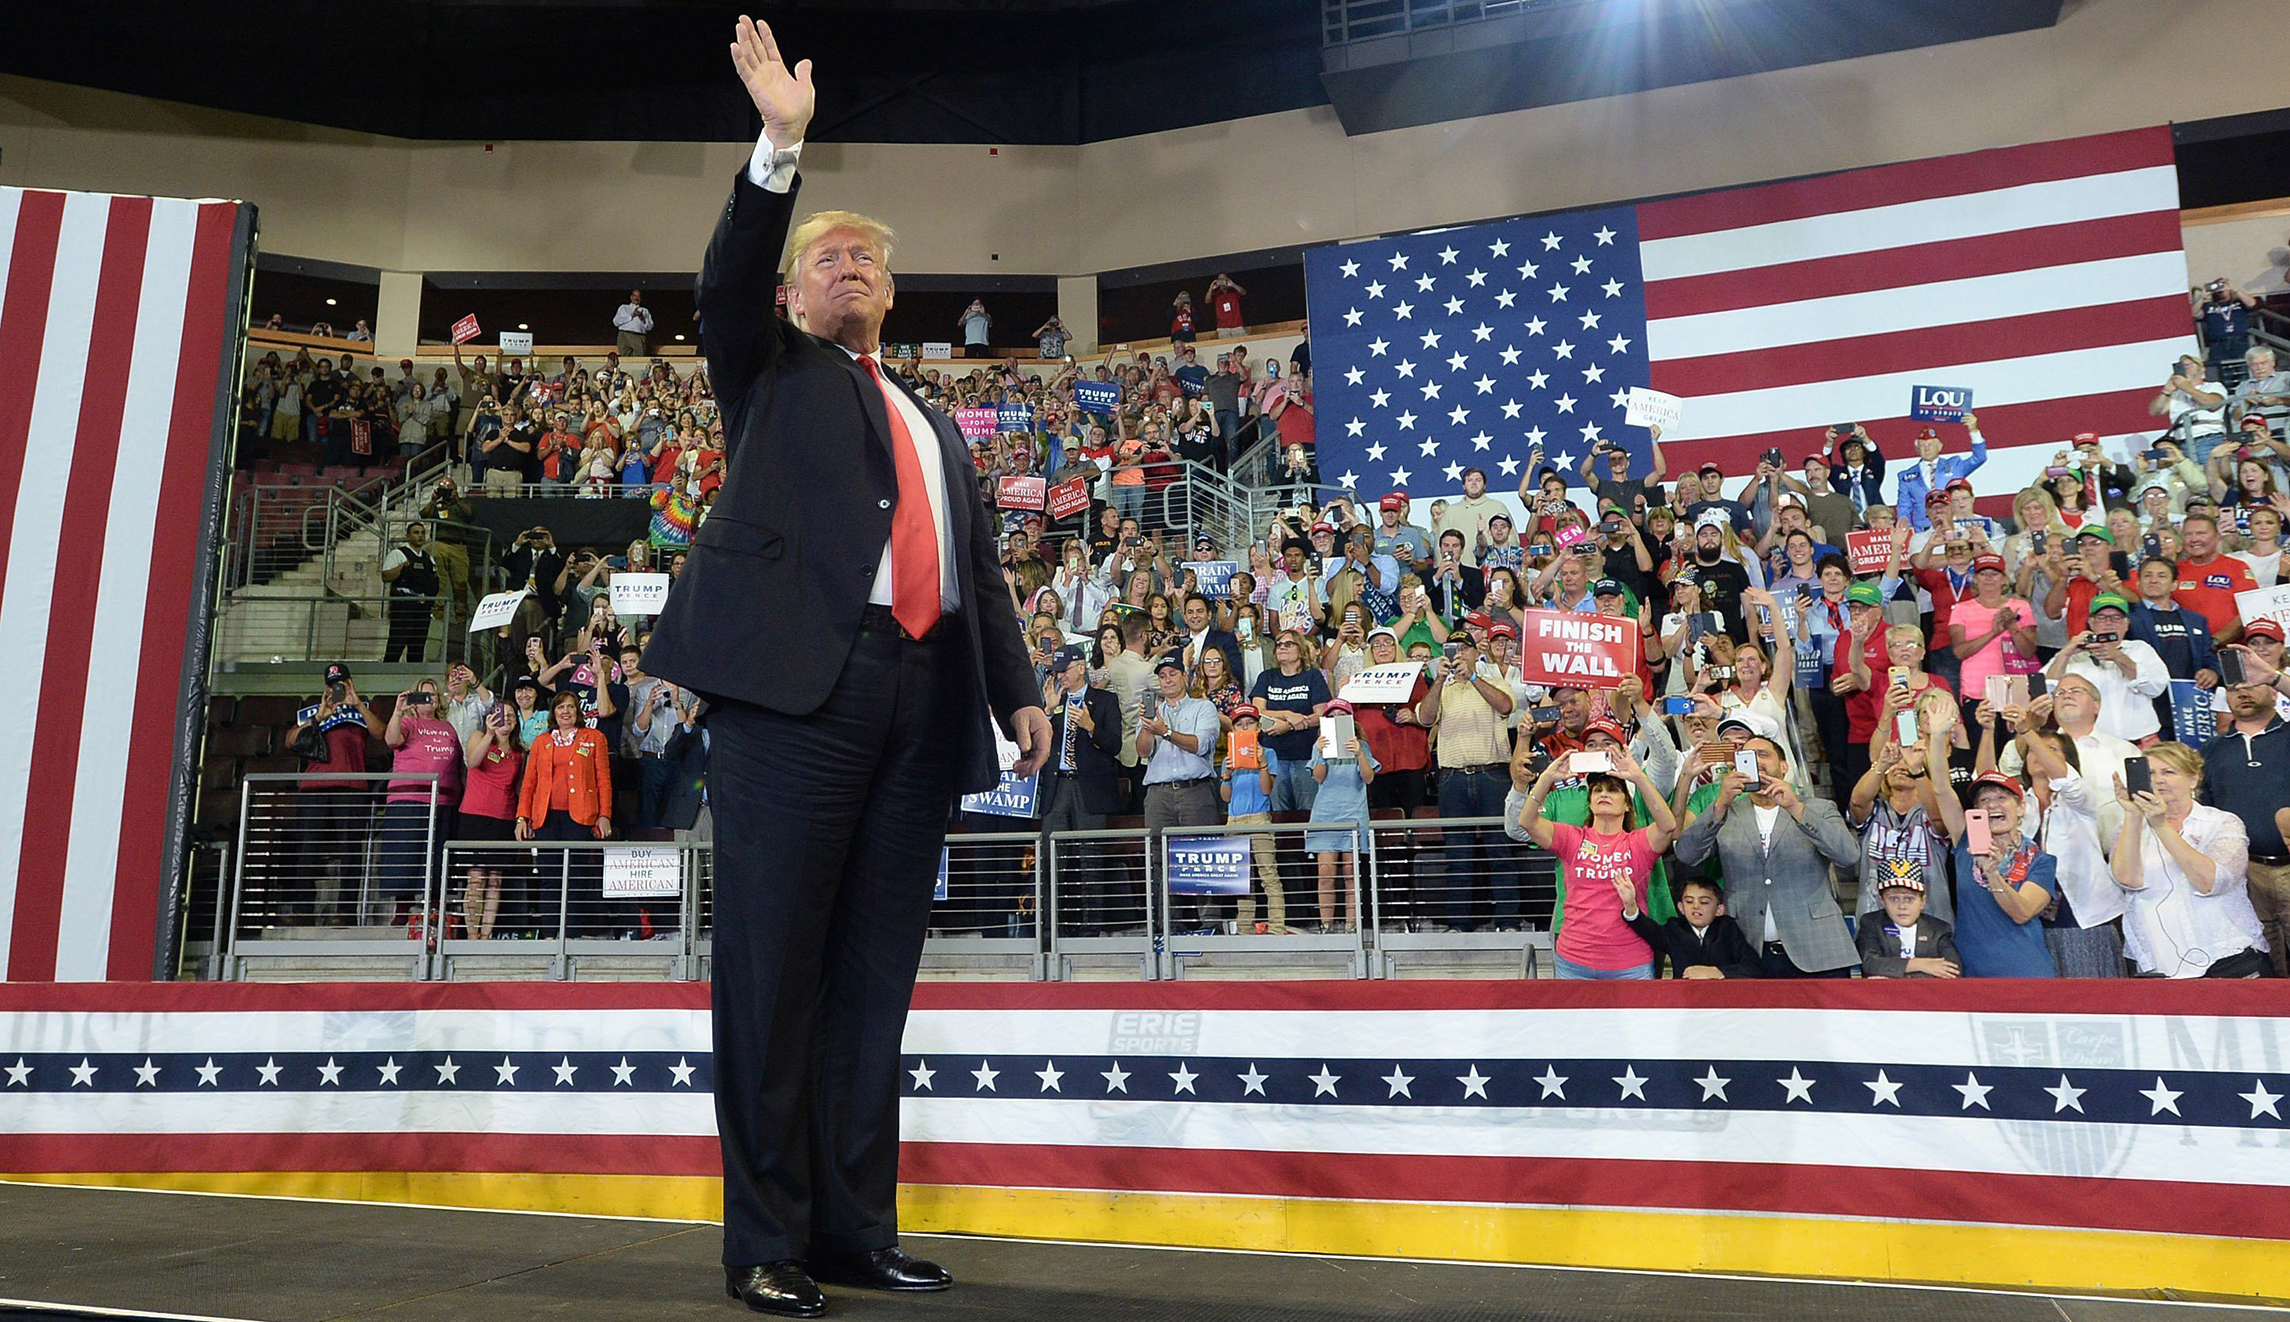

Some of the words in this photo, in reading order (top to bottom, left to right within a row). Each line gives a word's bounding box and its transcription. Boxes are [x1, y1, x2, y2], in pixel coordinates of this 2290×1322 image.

[1078, 389, 1116, 398] TRUMP
[1919, 388, 1965, 407] LOU
[957, 410, 997, 419] WOMEN
[999, 411, 1032, 420] TRUMP
[1631, 403, 1679, 420] AMERICA
[1001, 486, 1043, 498] AMERICA
[1052, 488, 1086, 506] AMERICA
[1556, 525, 1582, 544] EN
[1858, 555, 1885, 565] GREAT
[2206, 575, 2230, 584] LOU
[614, 585, 663, 593] TRUMP
[1197, 584, 1230, 594] WAM
[481, 598, 517, 609] TRUMP
[1539, 619, 1622, 643] FINISH
[1565, 642, 1592, 653] THE
[1541, 653, 1618, 677] WALL
[2182, 707, 2195, 736] MAKE
[425, 744, 454, 754] Trump
[997, 782, 1011, 792] HE
[968, 791, 1030, 809] SWAMP
[631, 850, 652, 858] BUY
[1175, 853, 1243, 864] TRUMP
[1576, 850, 1632, 864] WOMEN
[610, 858, 674, 869] AMERICAN
[1596, 862, 1613, 871] FOR
[630, 870, 653, 878] HIRE
[1575, 867, 1633, 879] TRUMP
[609, 879, 674, 890] AMERICAN
[1117, 1013, 1197, 1035] ERIE
[1113, 1037, 1193, 1052] SPORTS
[2066, 1026, 2119, 1056] Carpe
